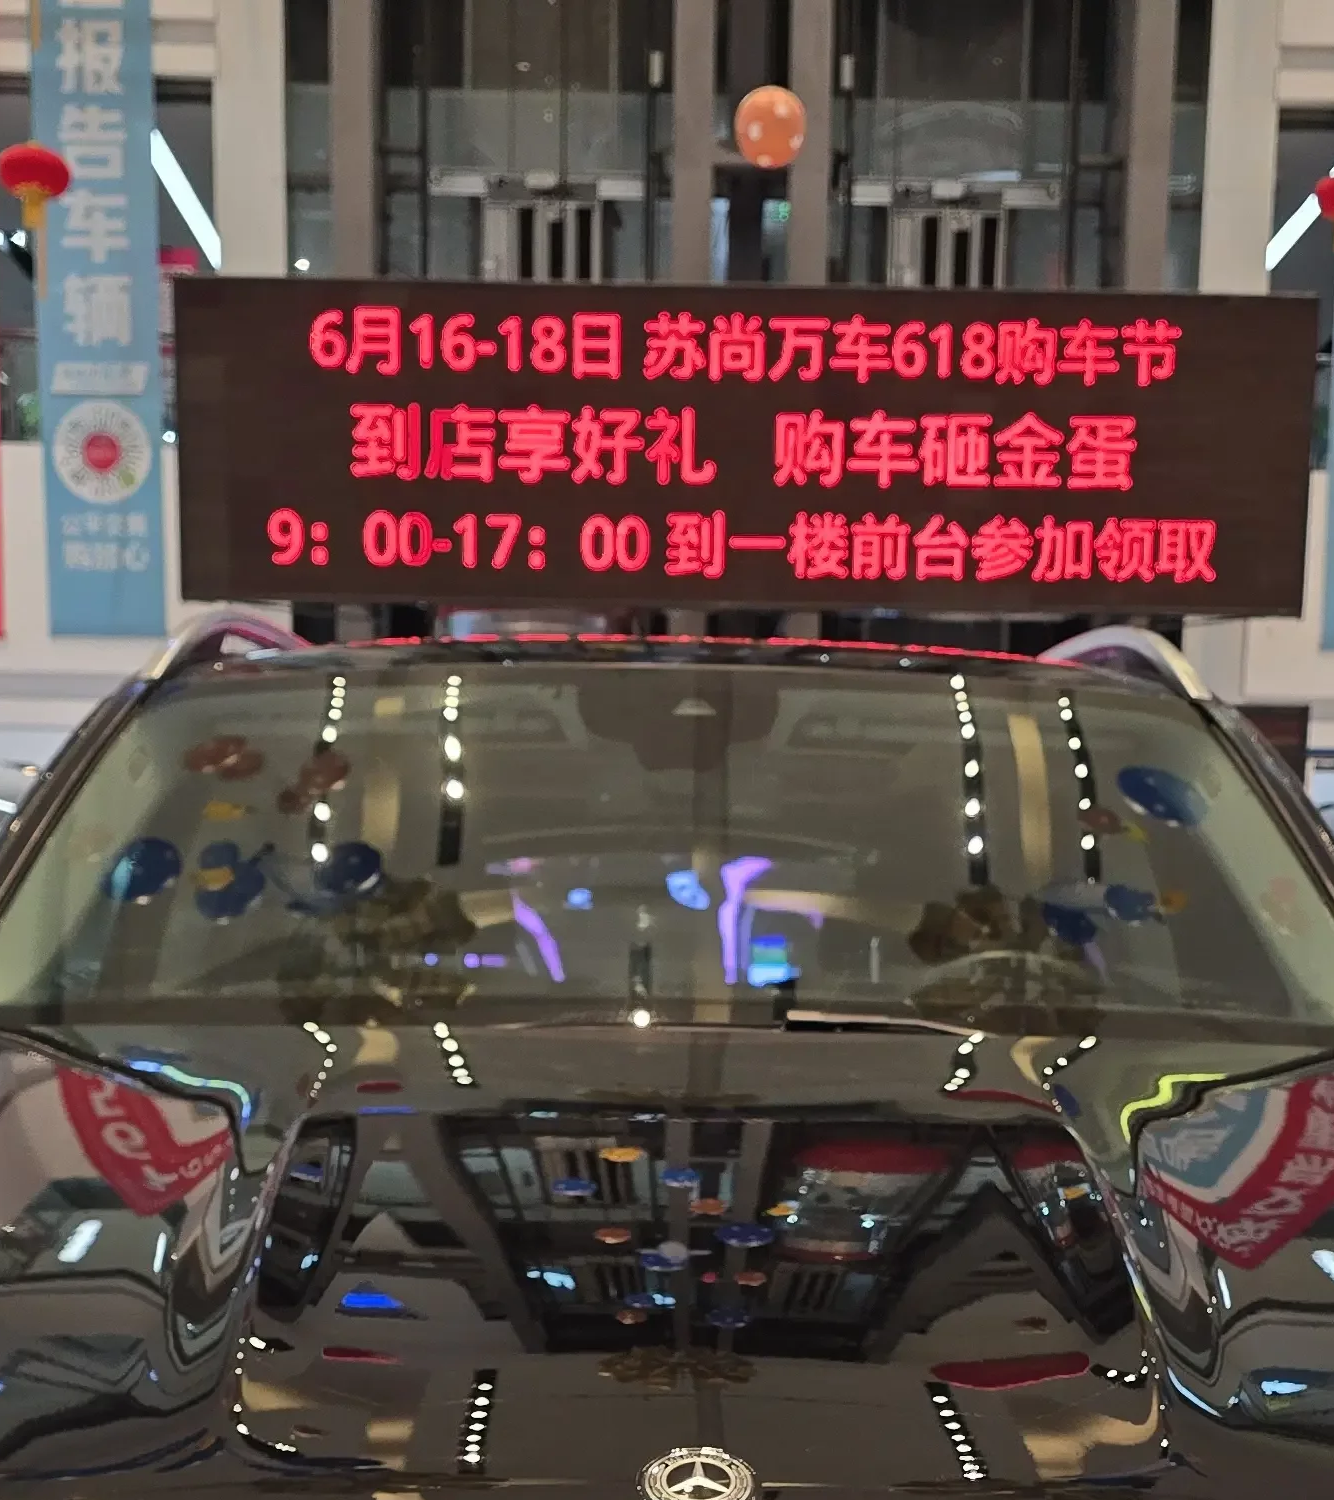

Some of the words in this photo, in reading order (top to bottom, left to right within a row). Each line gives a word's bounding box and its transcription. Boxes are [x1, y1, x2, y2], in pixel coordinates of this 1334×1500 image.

[55, 0, 134, 347] 报告车辆
[310, 306, 622, 379] 6月16-18日
[642, 311, 1183, 387] 苏尚万车618购车节
[350, 403, 717, 485] 到店享好礼
[773, 409, 1137, 491] 购车砸金蛋
[664, 510, 1216, 583] 到一楼前台参加领取
